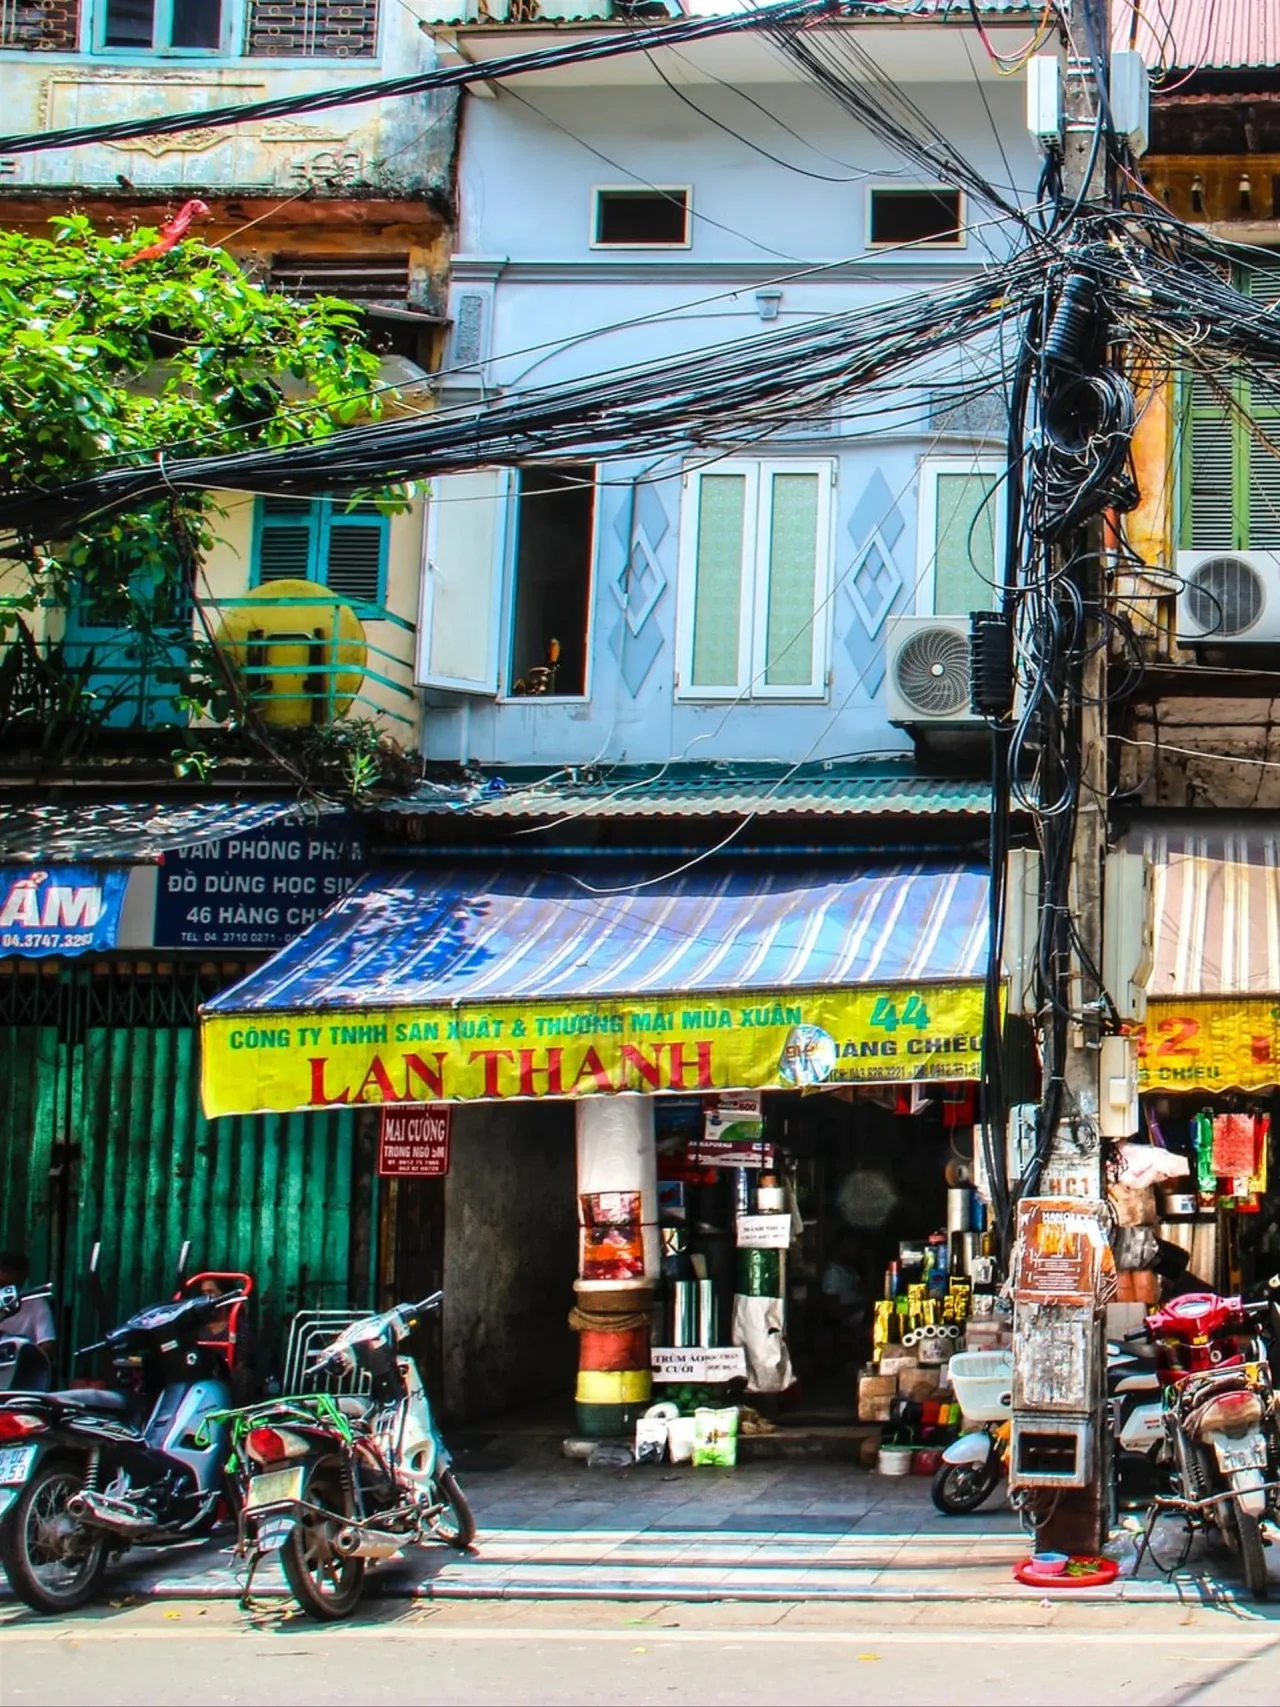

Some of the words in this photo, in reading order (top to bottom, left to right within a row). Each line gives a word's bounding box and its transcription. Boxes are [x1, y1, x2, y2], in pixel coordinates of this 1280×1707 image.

[228, 835, 301, 860] PHÒNG
[168, 868, 197, 892] ĐỒ
[205, 870, 265, 893] DÙNG
[273, 876, 316, 898] HỌC
[186, 907, 211, 924] 46
[218, 903, 279, 924] HÀNG
[181, 932, 200, 942] TEL:
[230, 1026, 290, 1049] CÔNG
[298, 1028, 322, 1046] TY
[329, 1024, 387, 1045] TNHH
[512, 1019, 526, 1037] &
[536, 1013, 623, 1036] THƯƠNG
[631, 1013, 673, 1034] MẠI
[682, 1003, 732, 1028] MÙA
[740, 1004, 802, 1027] XUÂN
[870, 996, 931, 1033] 44
[308, 1052, 449, 1105] LAN
[468, 1041, 713, 1098] THANH
[385, 1119, 405, 1141] MAI
[407, 1112, 446, 1142] CƯỜNG
[384, 1146, 410, 1158] TRONG
